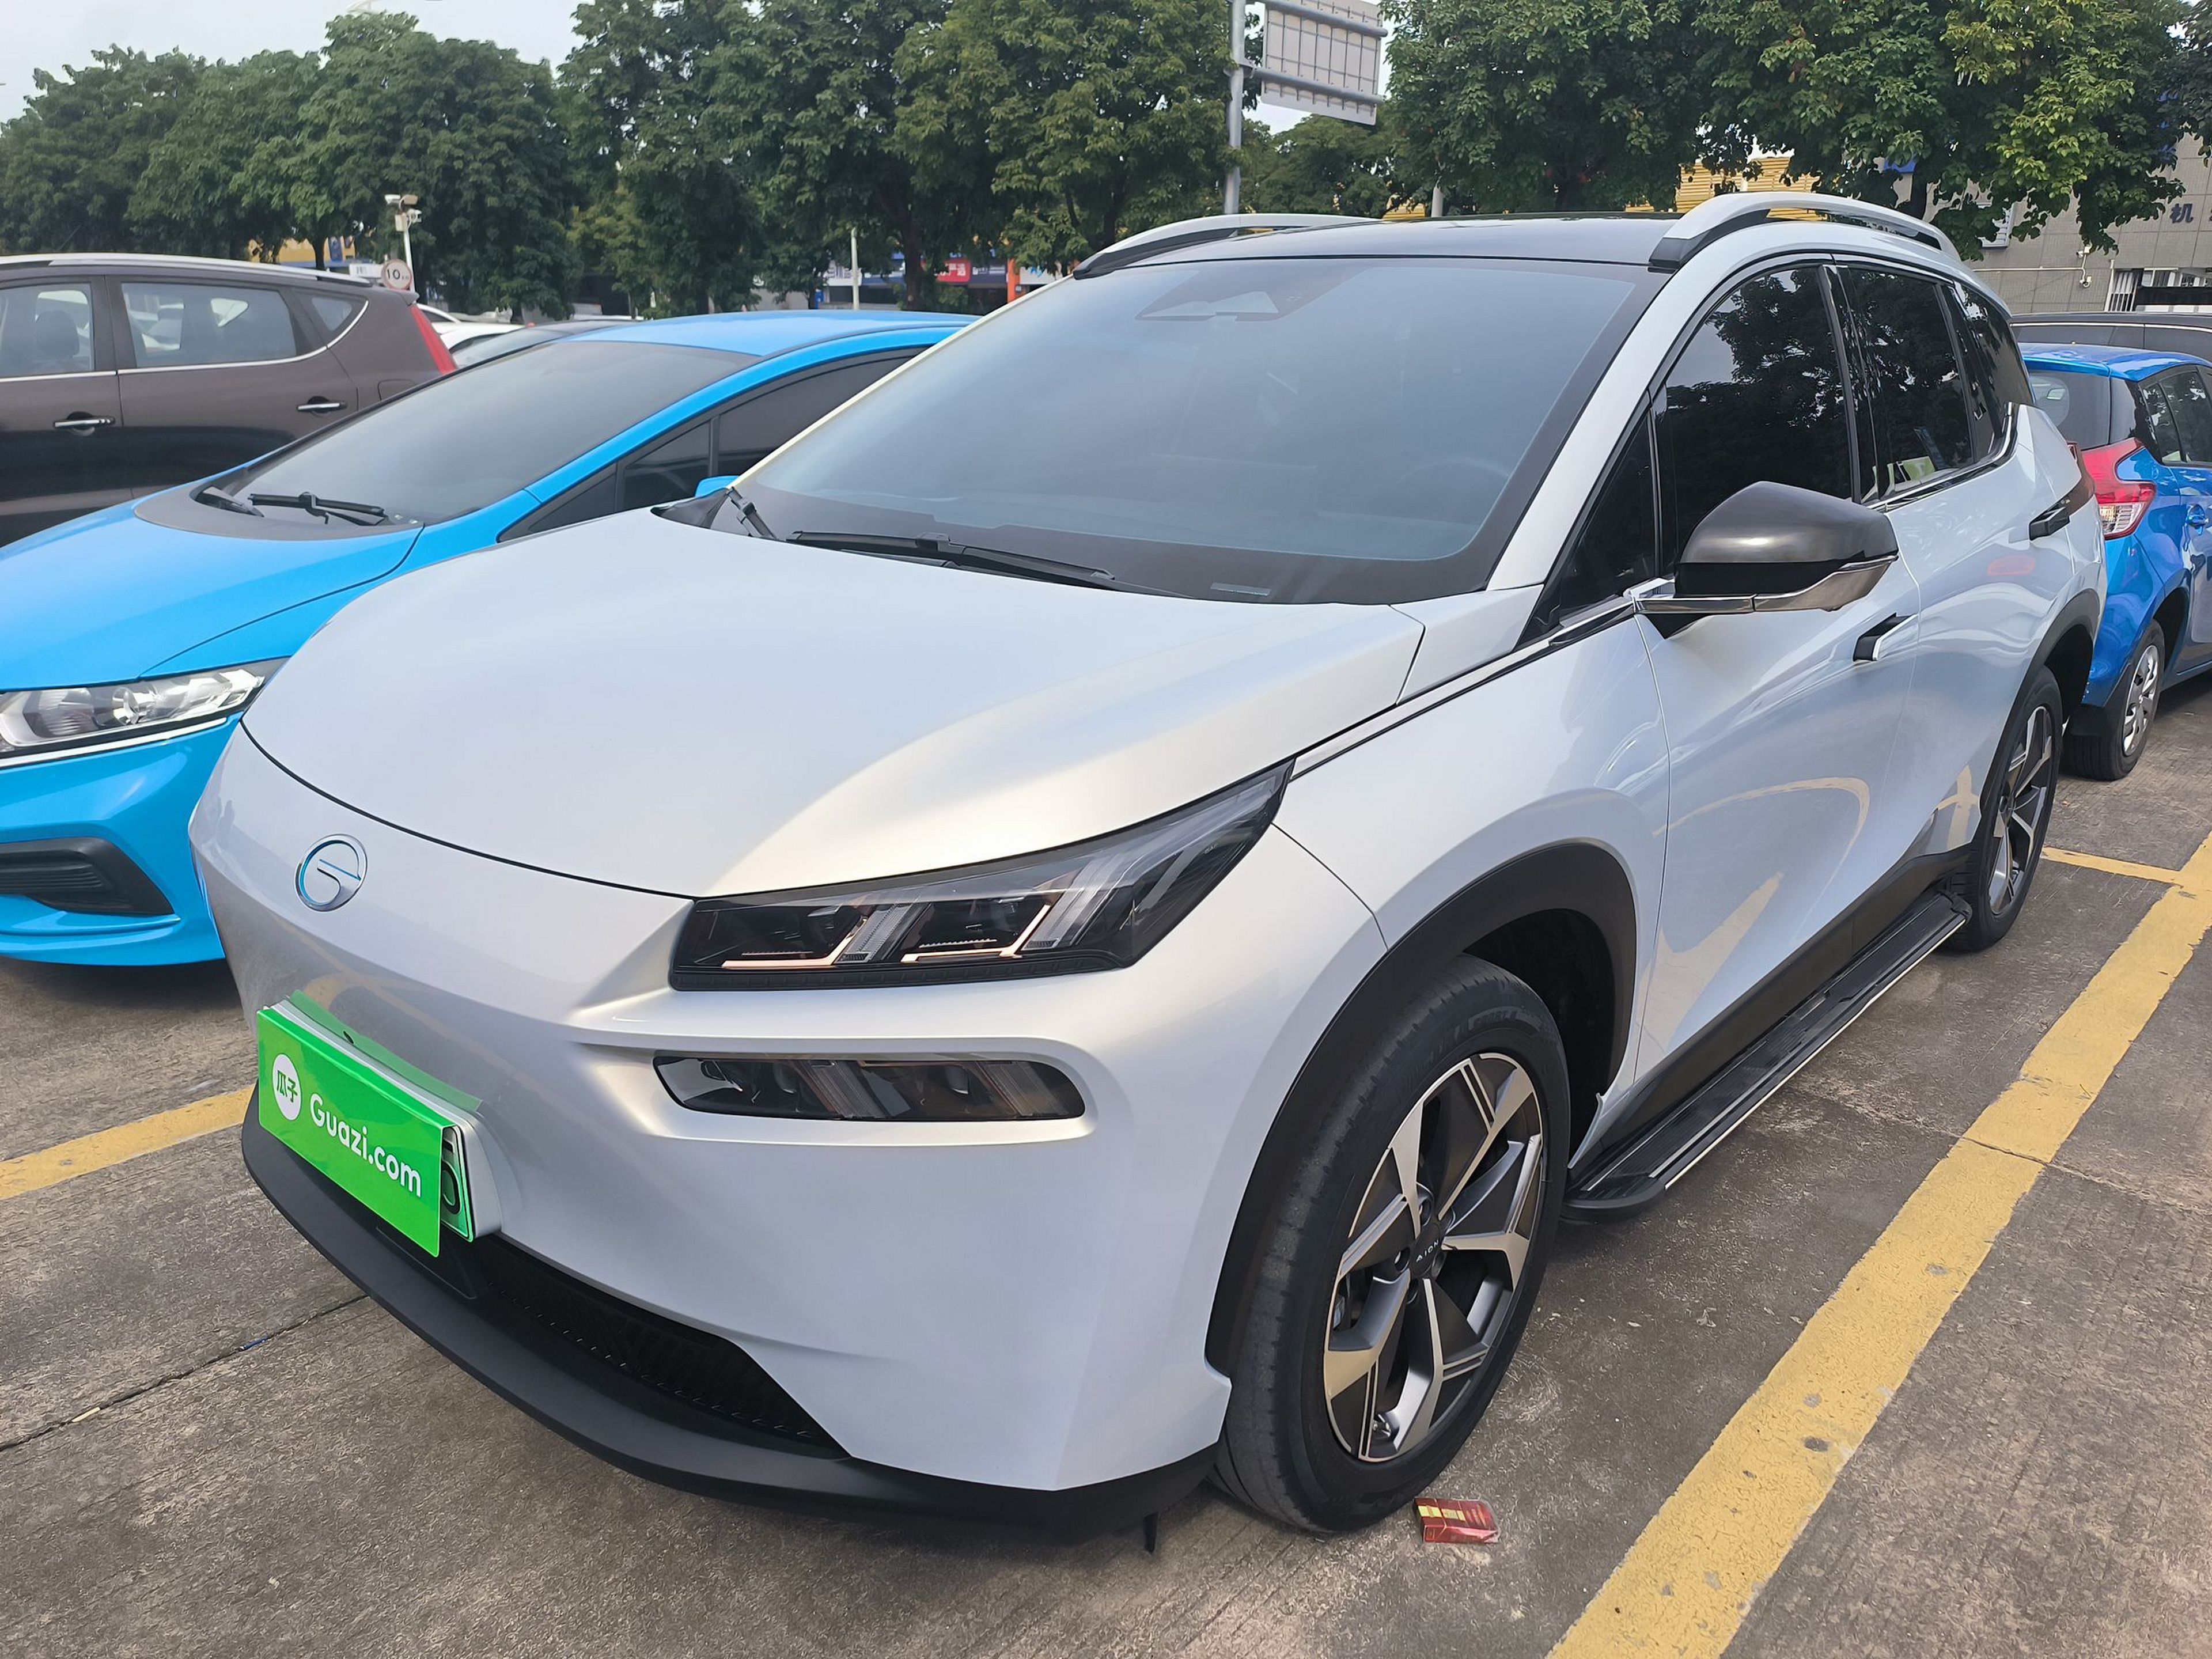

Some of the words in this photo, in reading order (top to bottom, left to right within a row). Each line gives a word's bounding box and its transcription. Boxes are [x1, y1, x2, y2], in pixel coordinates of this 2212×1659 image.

[2169, 203, 2194, 224] 机
[387, 268, 400, 280] 10
[276, 1069, 298, 1103] 瓜子
[310, 1093, 421, 1198] Guazi.com
[1416, 1239, 1439, 1263] AION
